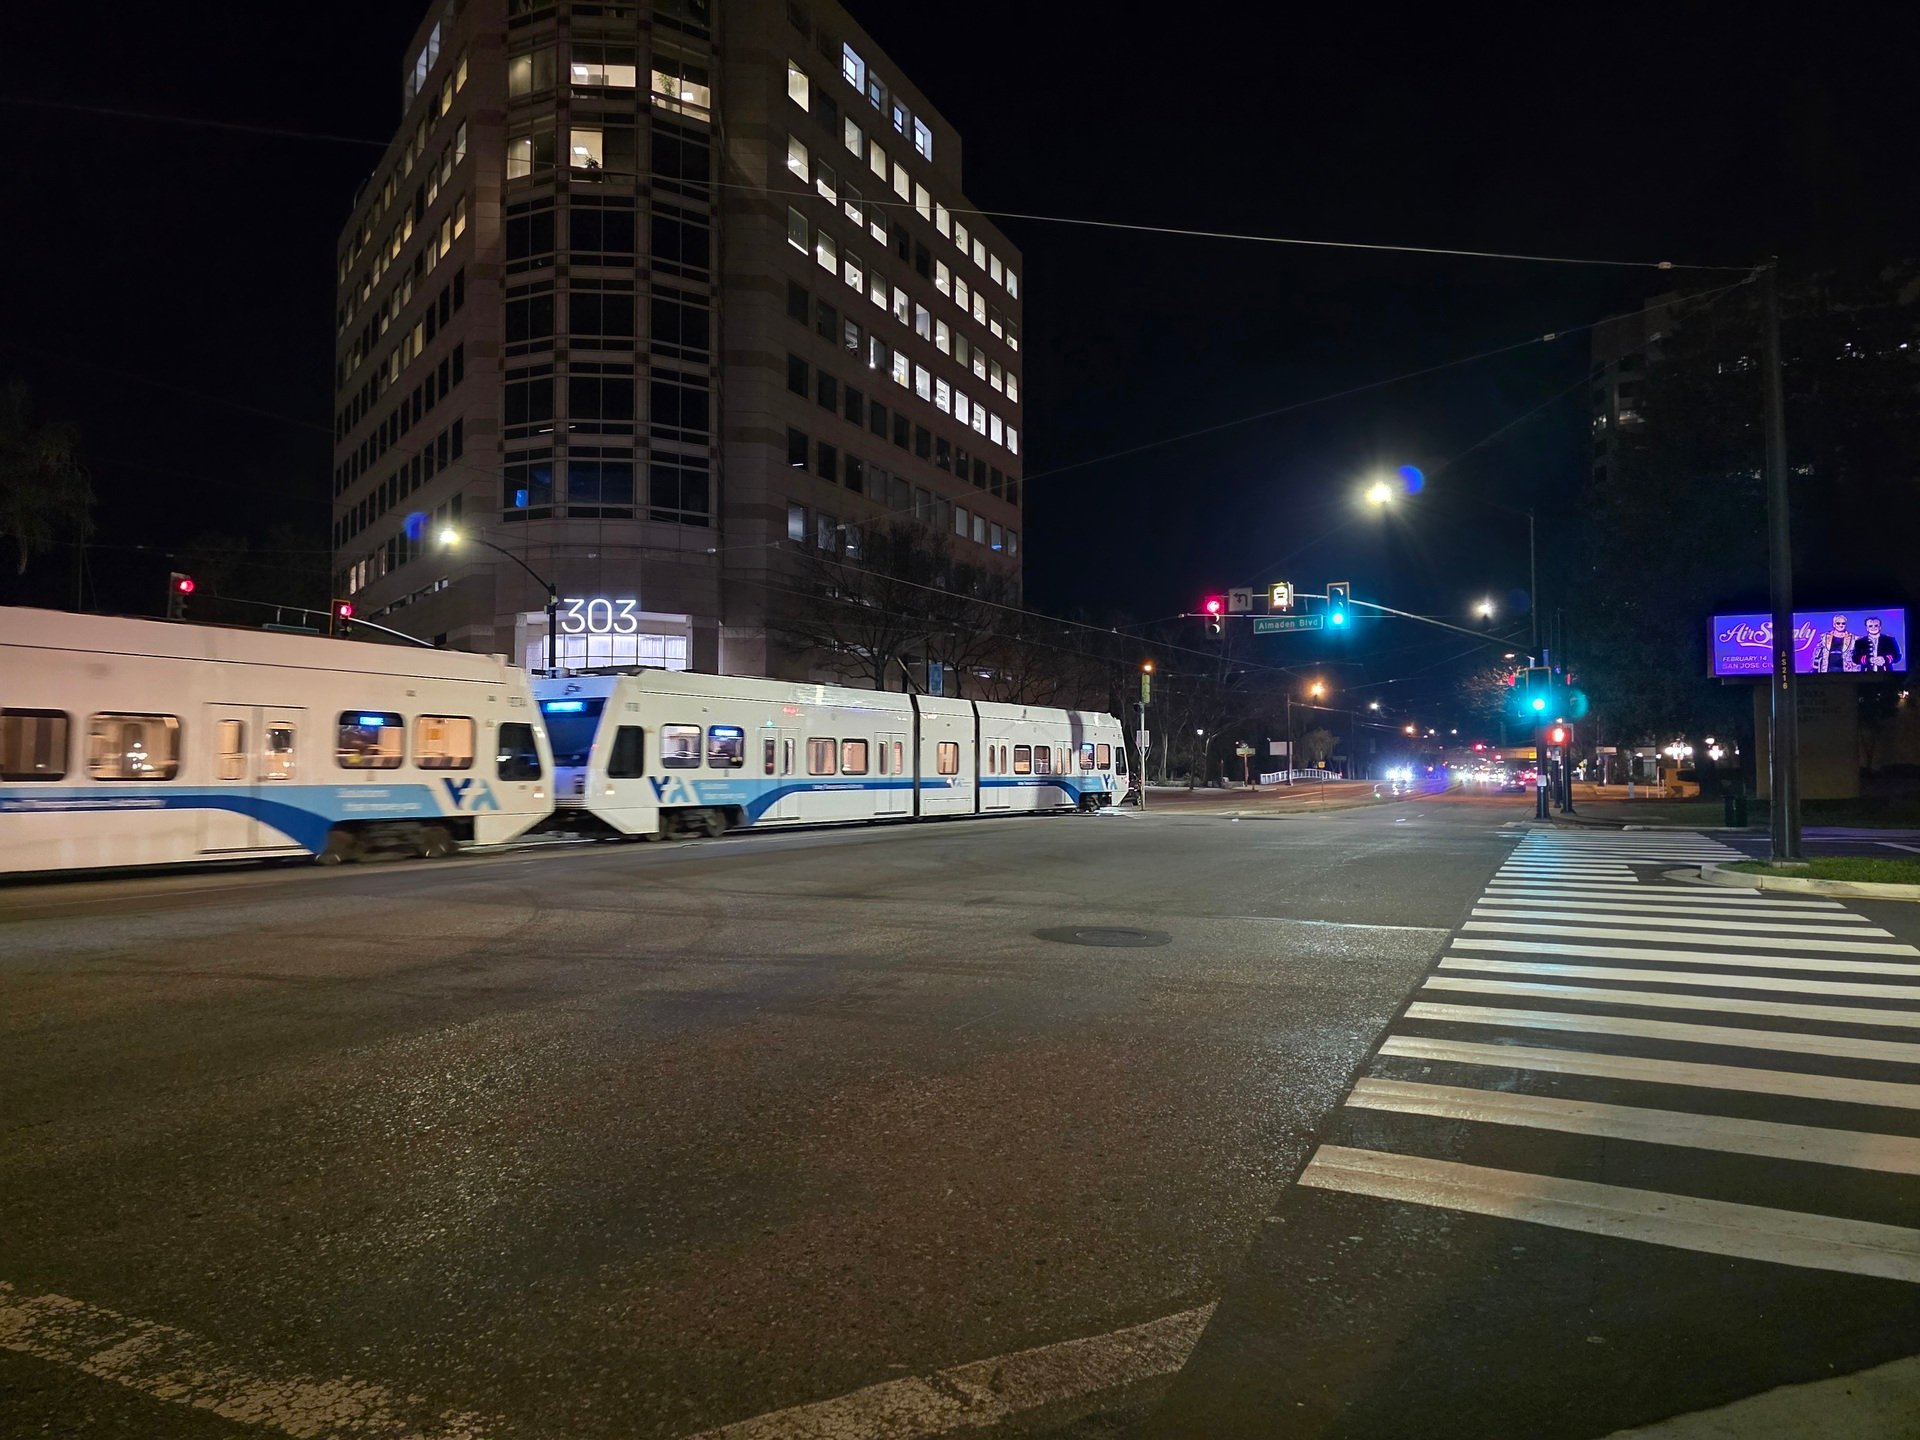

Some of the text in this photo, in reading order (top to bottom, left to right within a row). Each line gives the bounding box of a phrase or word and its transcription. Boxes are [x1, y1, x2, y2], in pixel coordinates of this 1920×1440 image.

[561, 598, 638, 634] 303
[1258, 618, 1318, 630] Almaden Blvd
[1719, 621, 1816, 651] Air Sply
